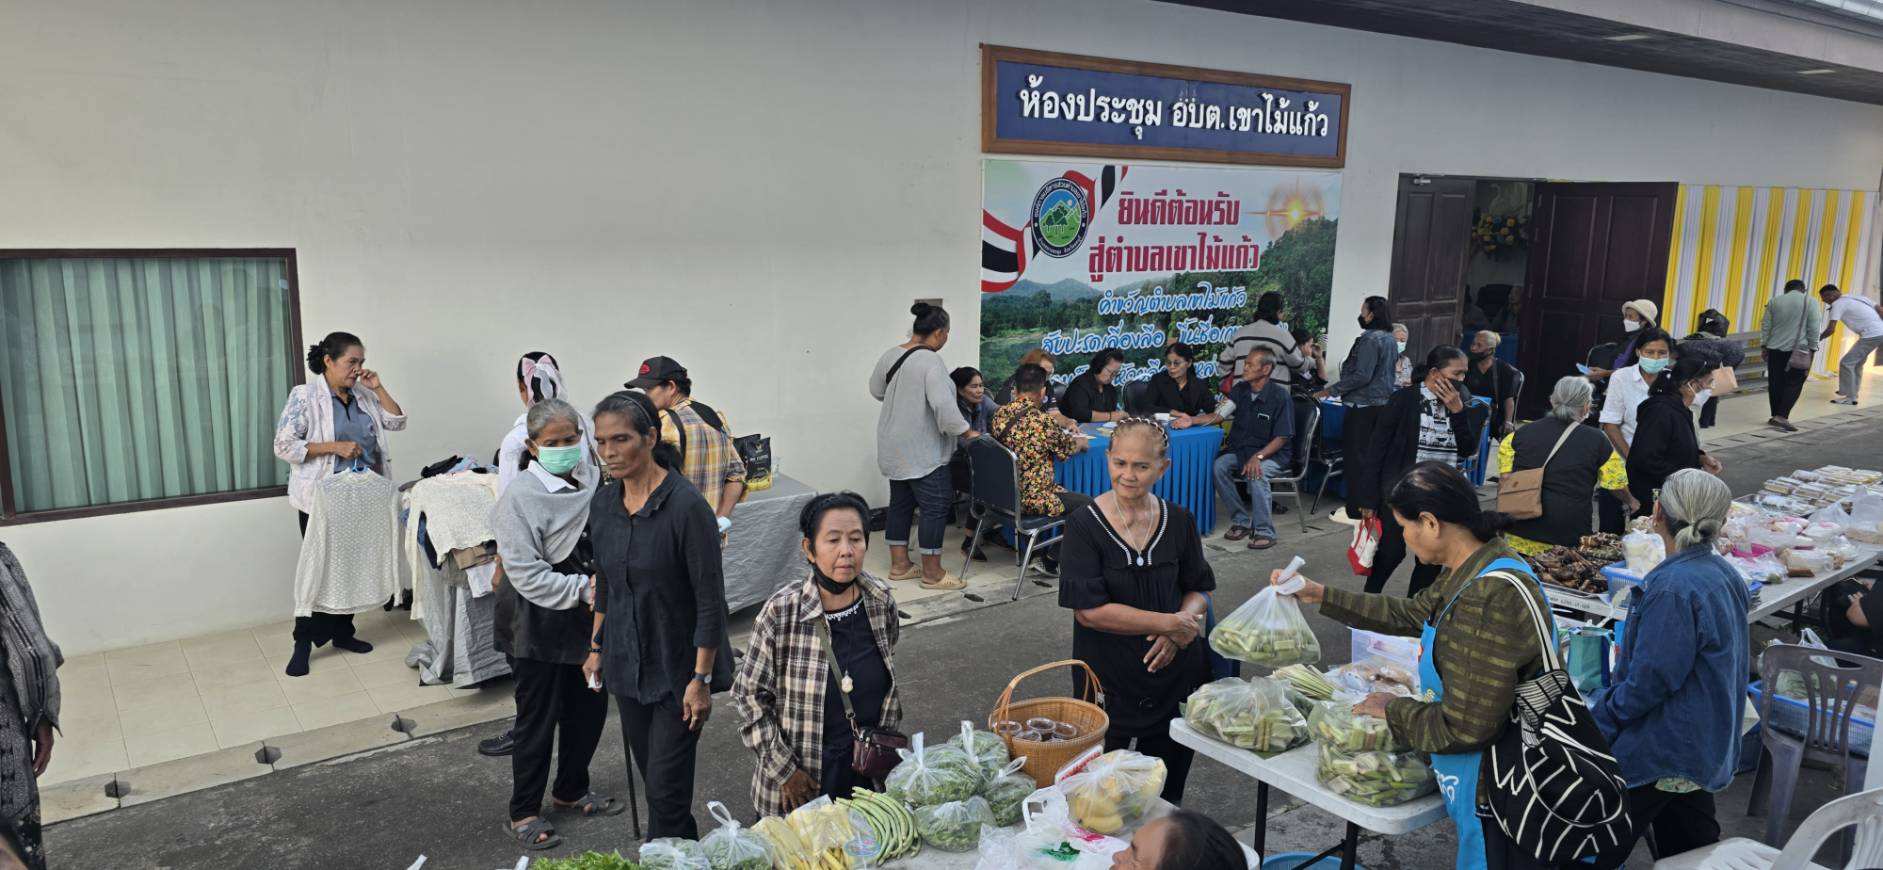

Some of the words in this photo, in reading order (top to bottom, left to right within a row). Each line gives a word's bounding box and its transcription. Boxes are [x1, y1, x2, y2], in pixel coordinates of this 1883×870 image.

[1019, 75, 1162, 140] ห้องประชุม
[1118, 189, 1240, 226] ยินดีต้อนรับ
[1089, 232, 1260, 283] สู่ตำบลเขาไม้แก้ว
